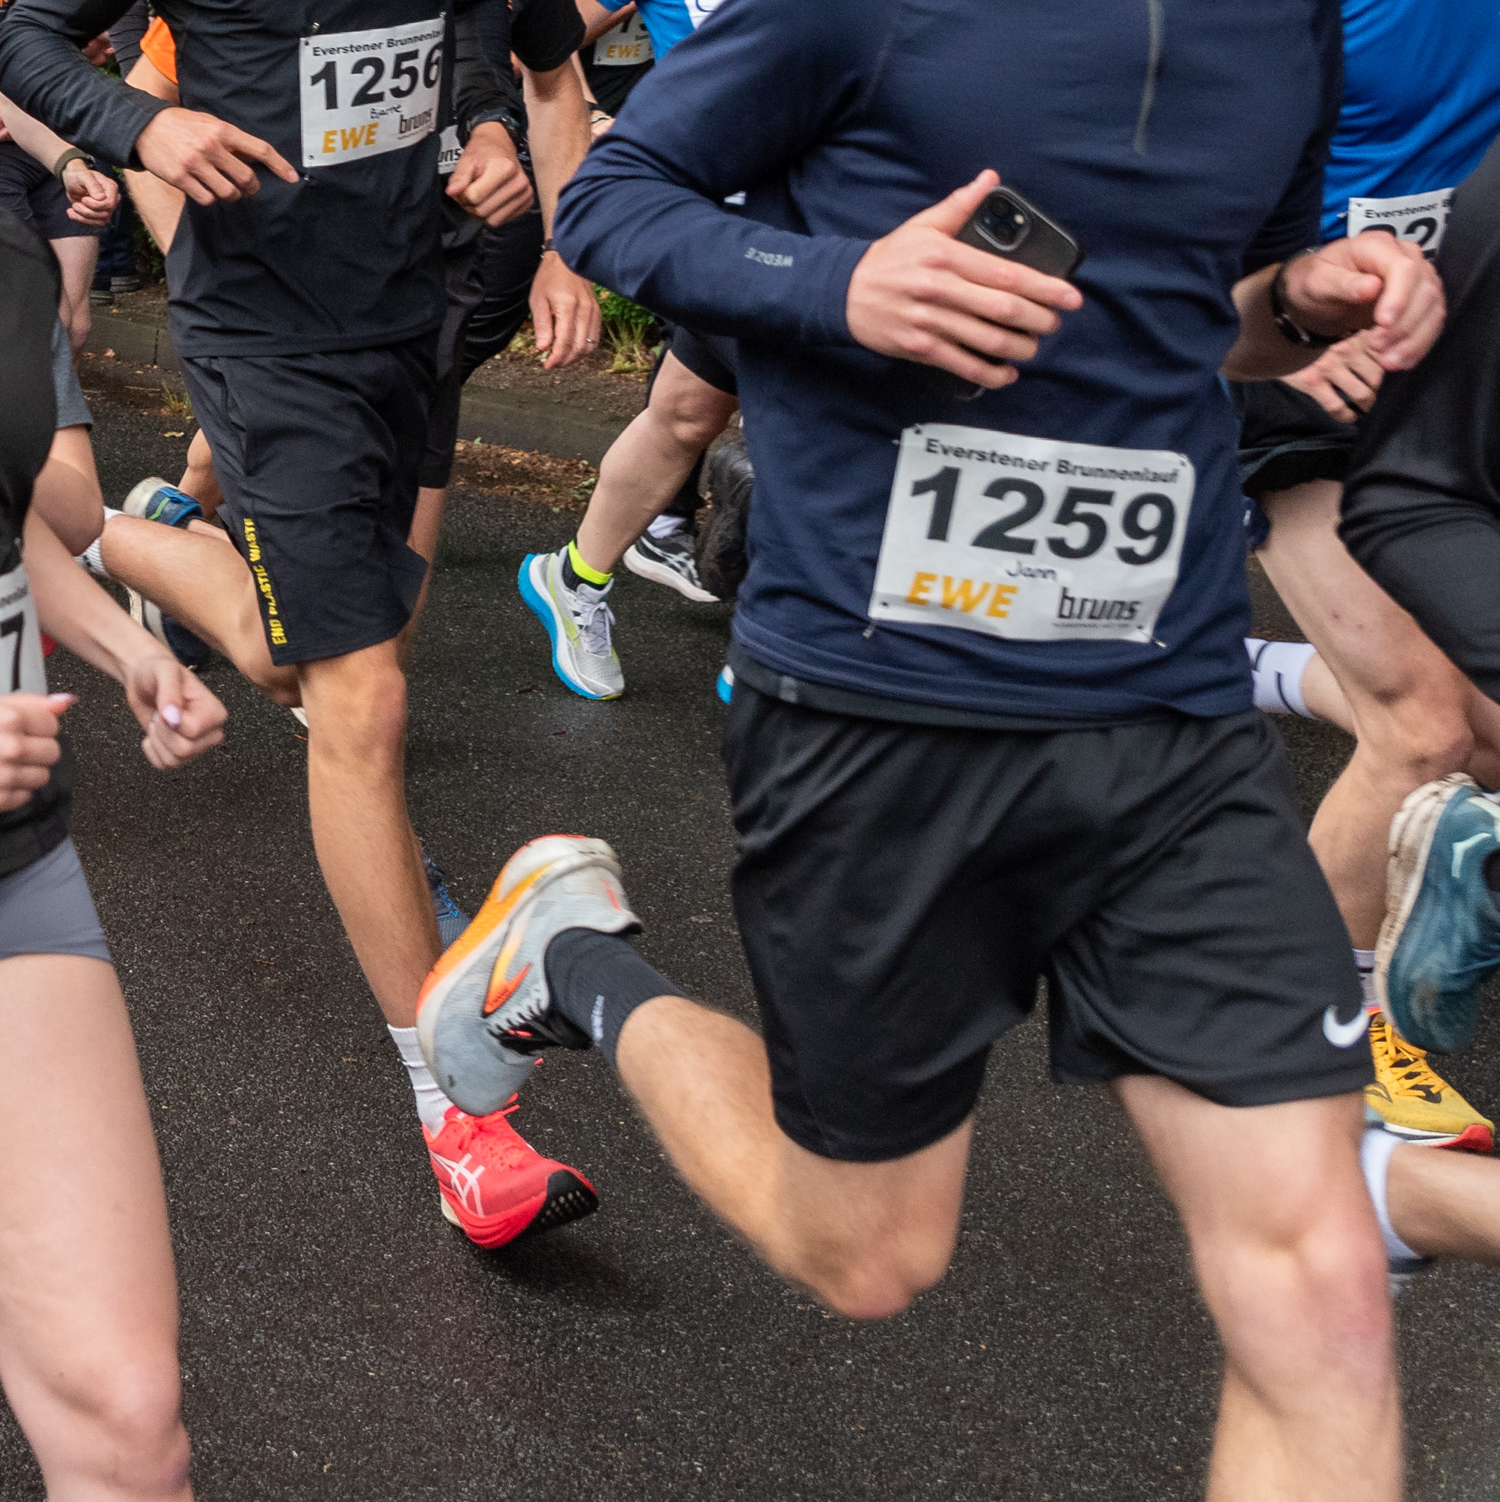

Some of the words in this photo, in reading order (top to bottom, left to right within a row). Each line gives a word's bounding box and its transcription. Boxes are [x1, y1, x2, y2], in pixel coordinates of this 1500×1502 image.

[313, 43, 383, 57] Everstener
[310, 41, 443, 110] 1256
[322, 122, 379, 153] EWE
[925, 438, 1050, 472] Everstener
[1057, 459, 1180, 484] Brunnenlauf
[910, 465, 1176, 566] 1259
[244, 518, 261, 561] WASTE
[253, 565, 278, 615] PLASTIC
[904, 571, 1019, 619] EWE
[1058, 586, 1141, 620] bruns
[269, 619, 288, 645] END
